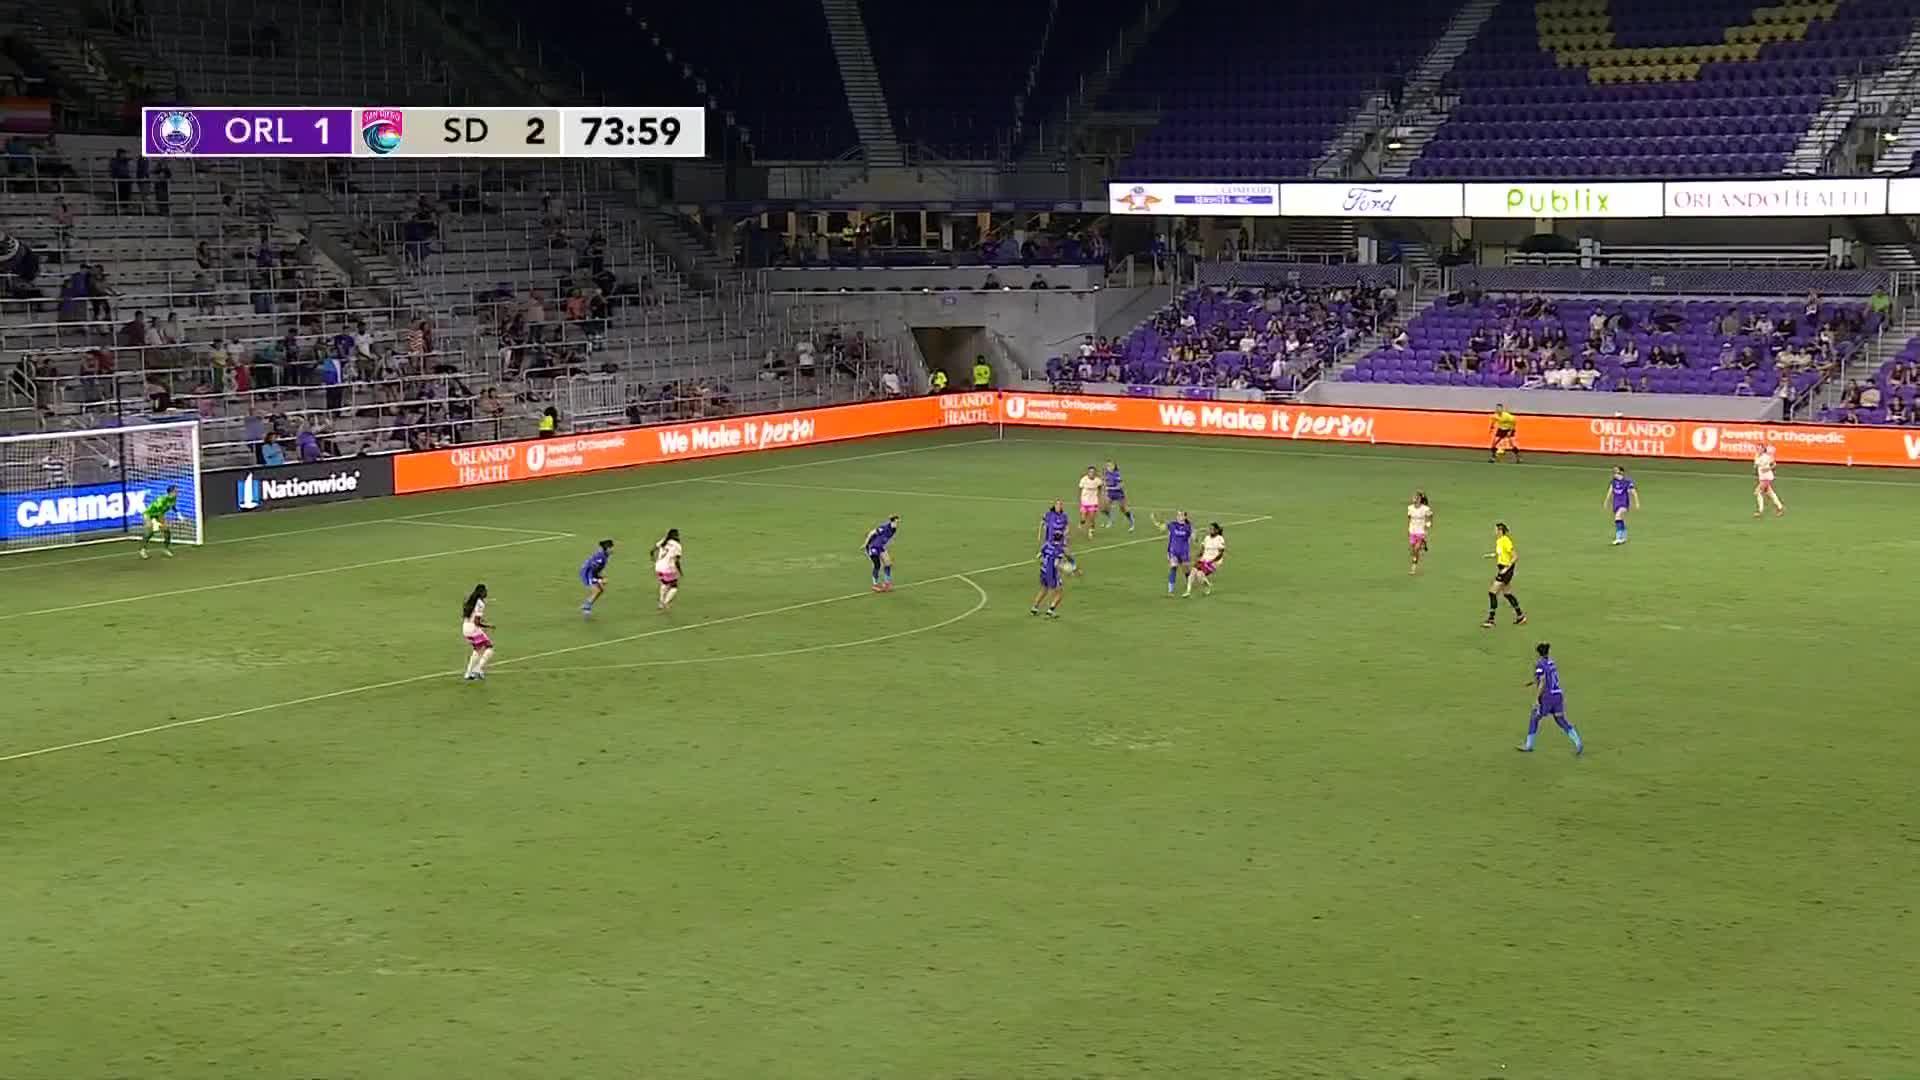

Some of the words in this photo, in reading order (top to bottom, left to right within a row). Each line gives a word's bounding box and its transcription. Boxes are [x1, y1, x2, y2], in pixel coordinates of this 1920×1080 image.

[1342, 188, 1397, 212] Ford
[1507, 188, 1609, 212] Publix
[939, 393, 993, 409] ORLANDO
[1159, 404, 1196, 427] We
[1200, 406, 1266, 431] Make
[1590, 418, 1676, 438] ORLANDO
[1767, 430, 1846, 446] Orthopedic
[659, 430, 689, 455] We
[691, 424, 741, 450] Make
[1600, 436, 1665, 456] HEALTH
[452, 446, 516, 466] ORLANDO
[458, 464, 510, 484] HEALTH
[262, 471, 357, 500] Nationwide
